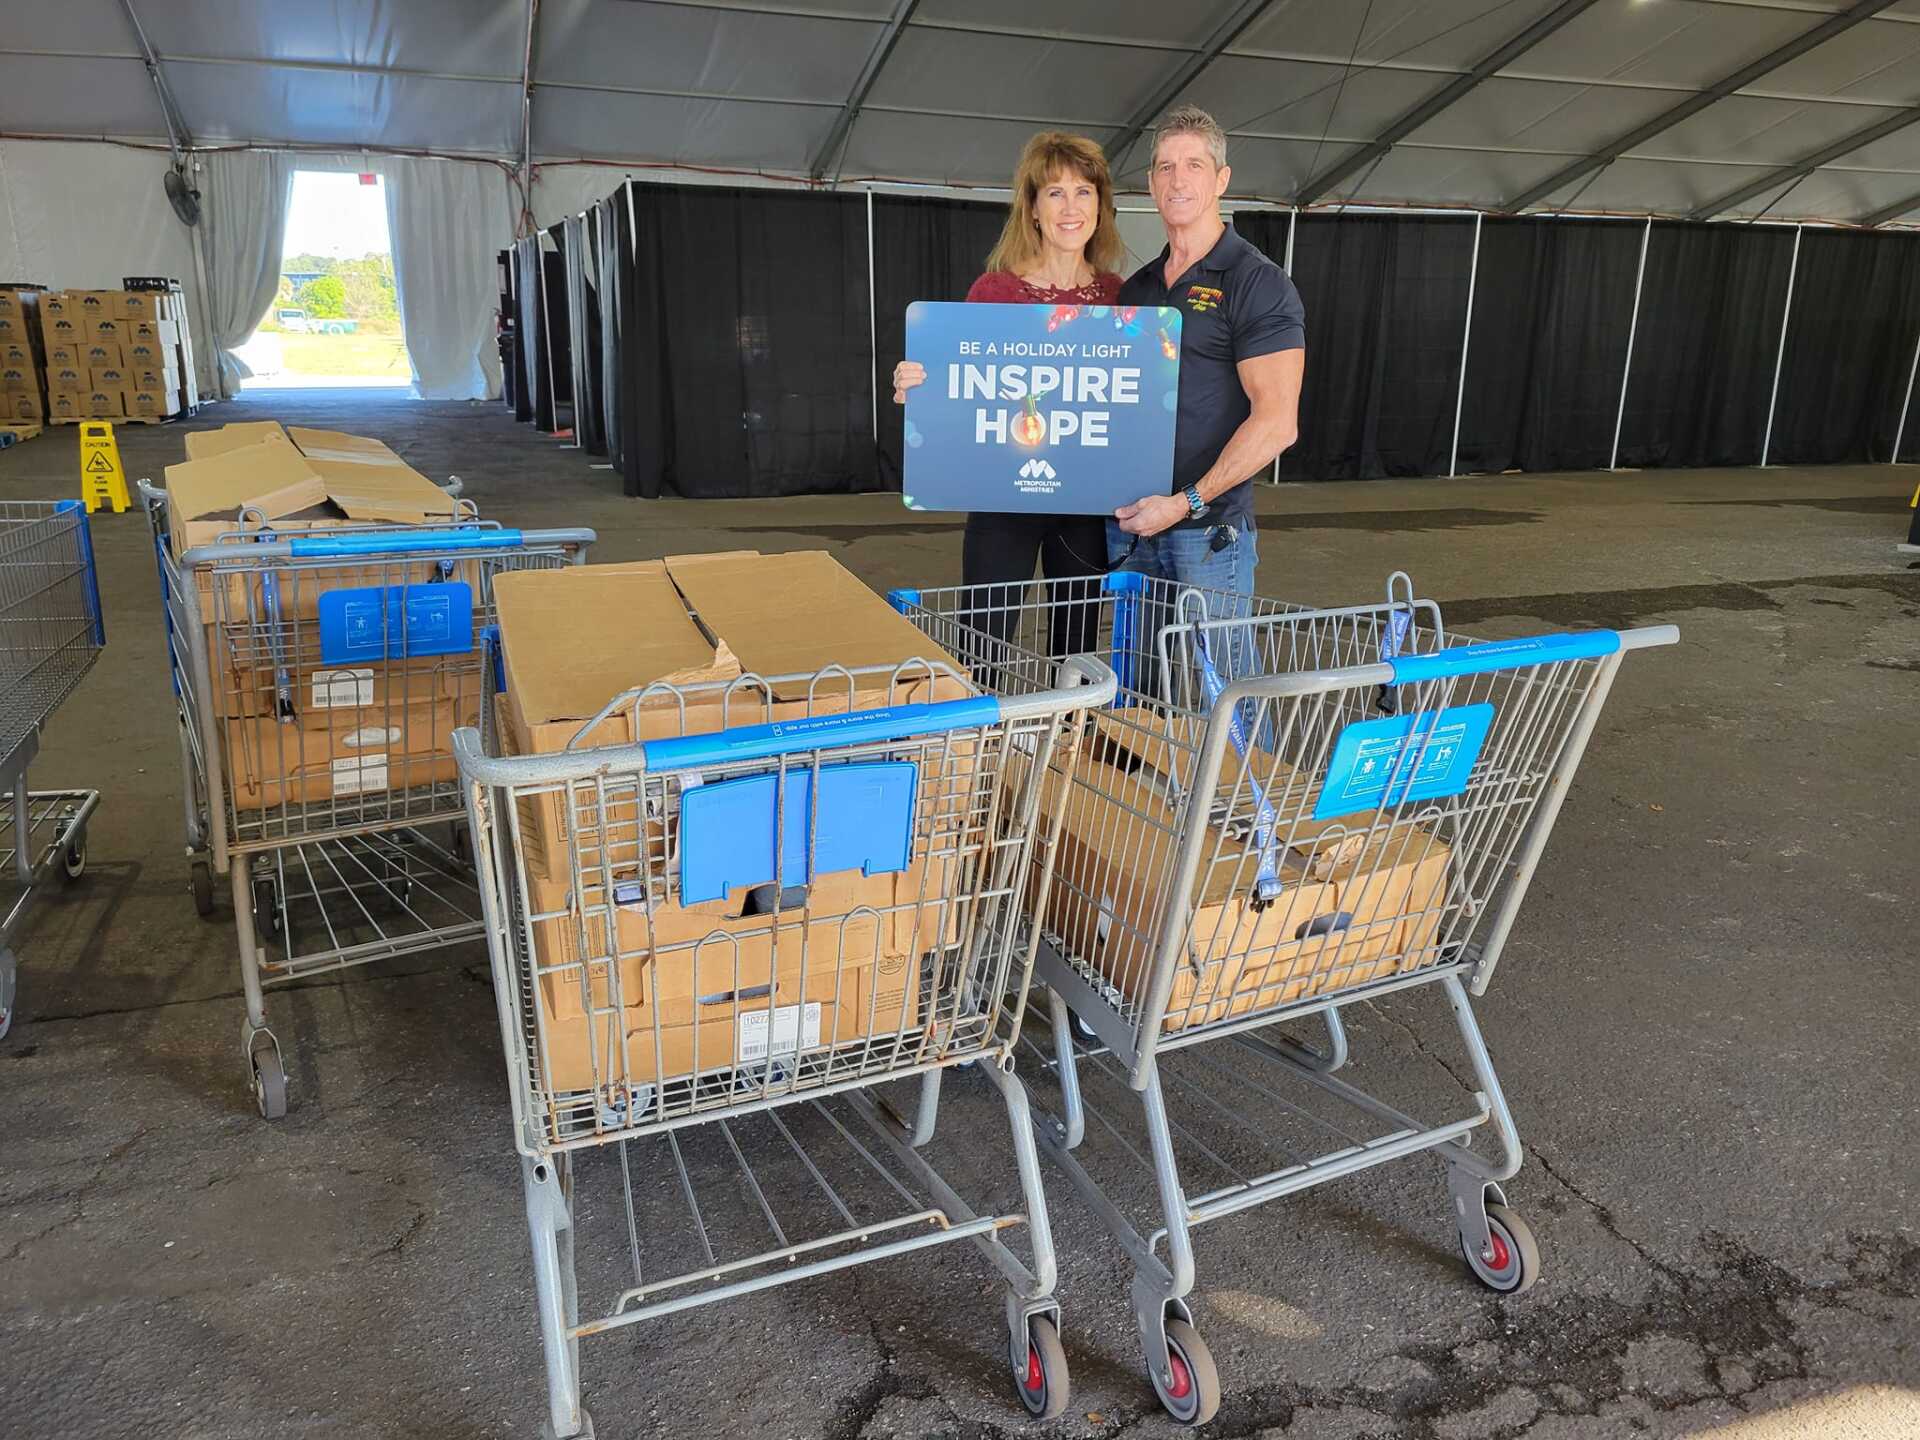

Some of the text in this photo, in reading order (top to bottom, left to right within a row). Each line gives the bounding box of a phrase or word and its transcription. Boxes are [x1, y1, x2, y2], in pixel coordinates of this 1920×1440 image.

[960, 342, 1132, 358] BE A HOLIDAY LIGHT
[948, 363, 1141, 404] INSPIRE
[975, 407, 1110, 447] HOPE
